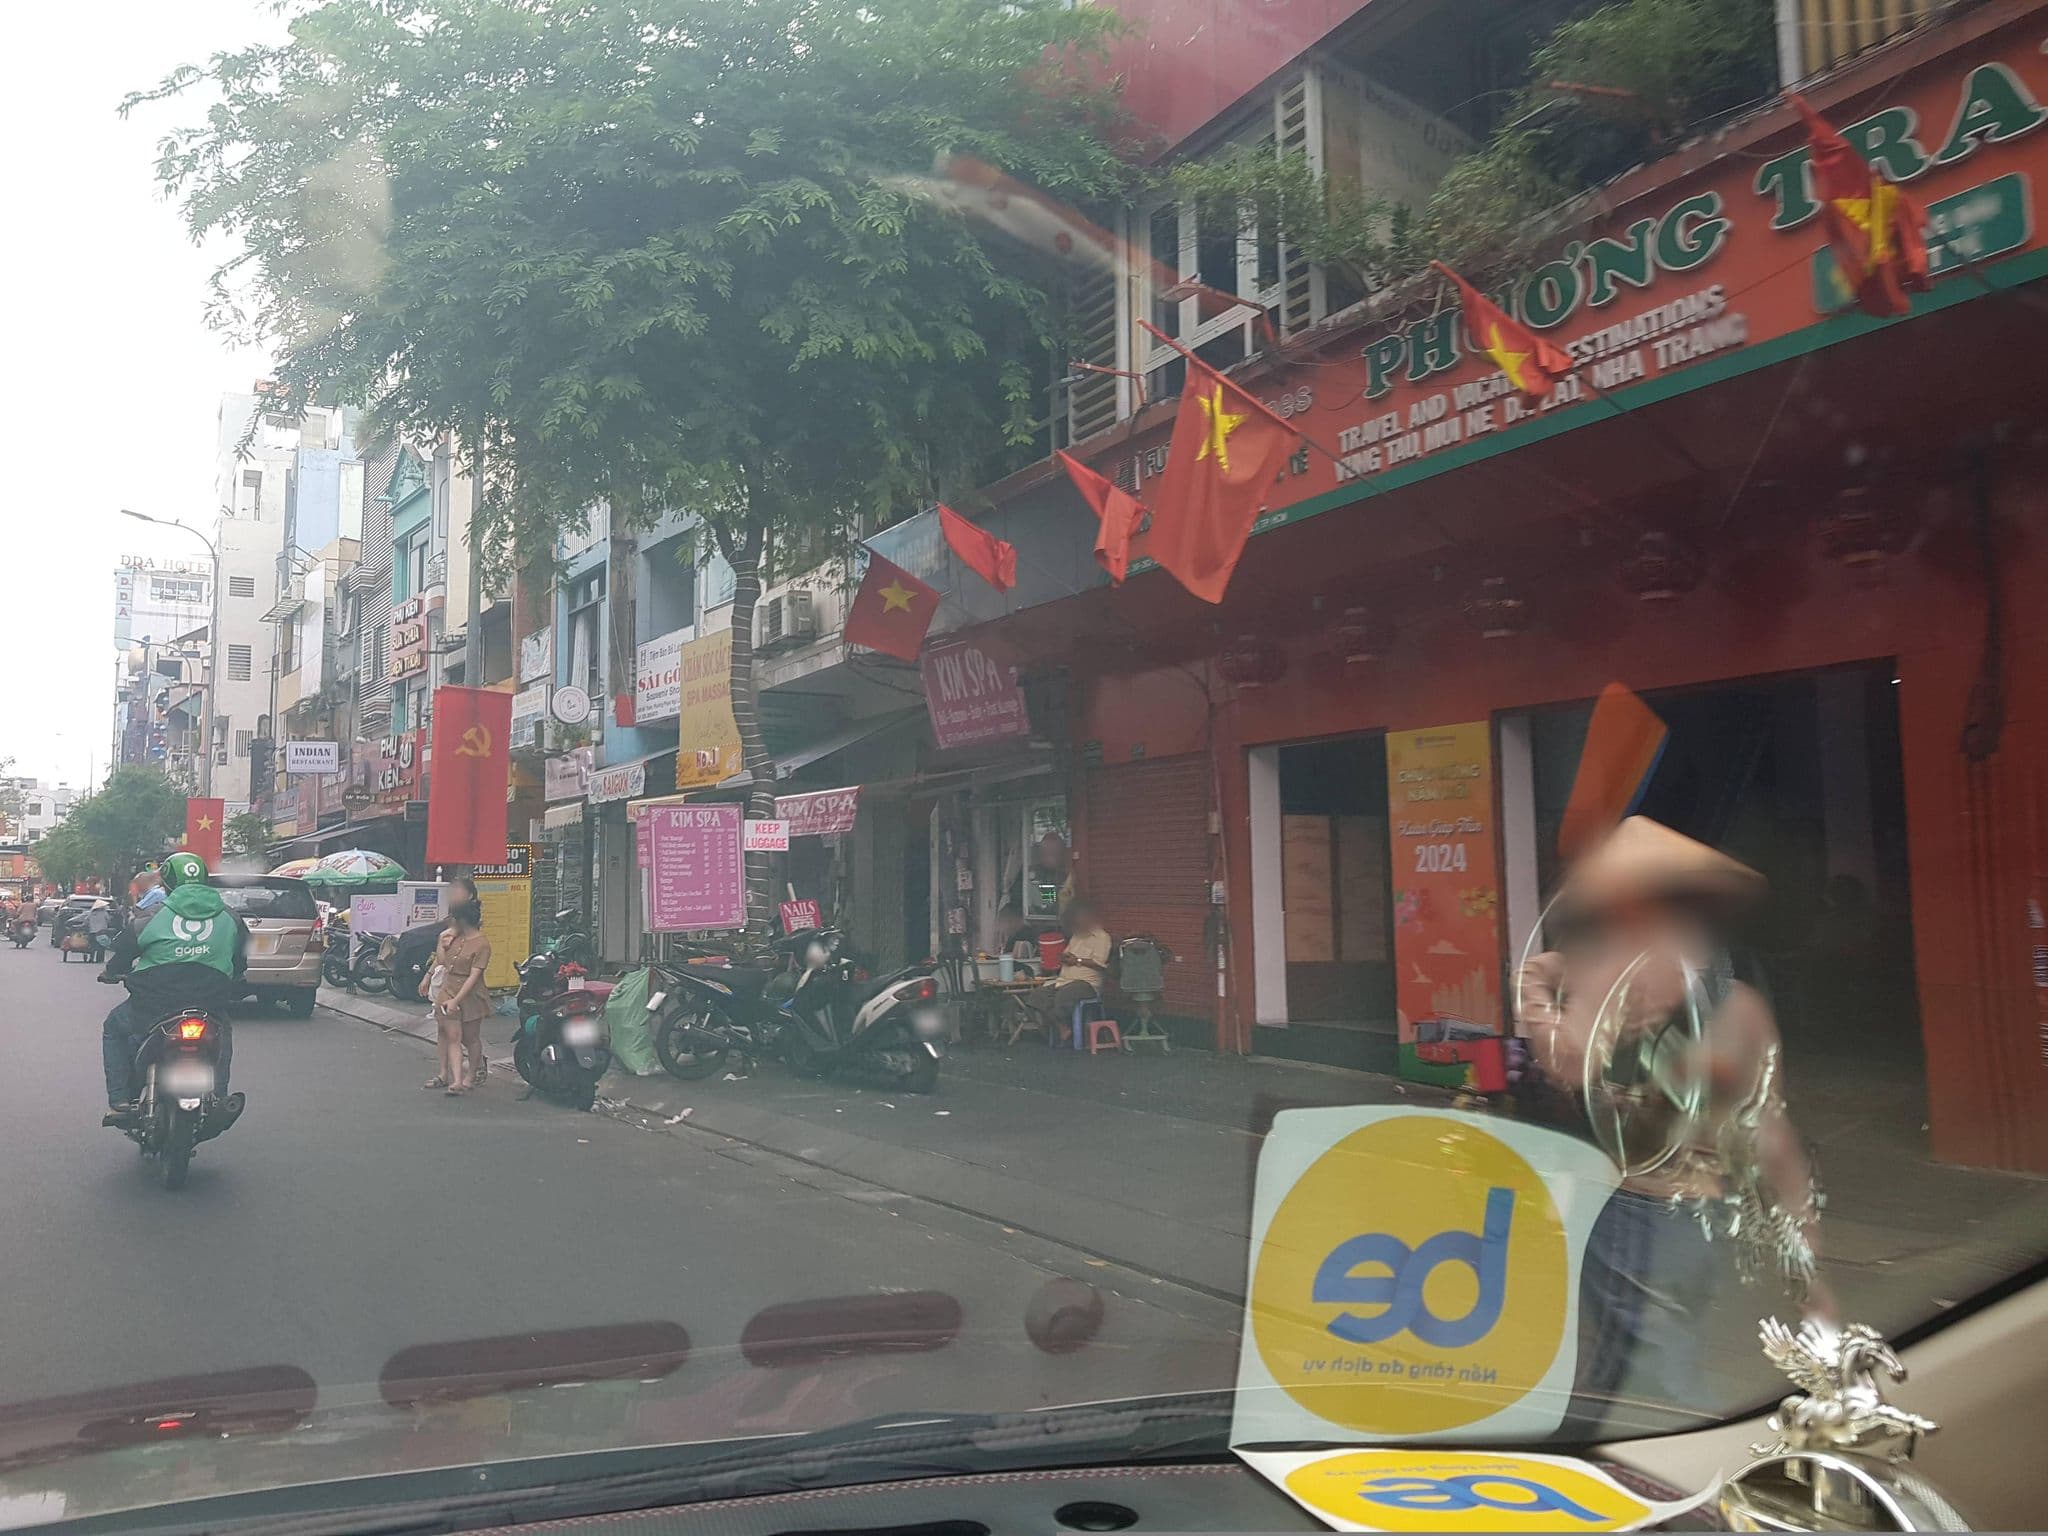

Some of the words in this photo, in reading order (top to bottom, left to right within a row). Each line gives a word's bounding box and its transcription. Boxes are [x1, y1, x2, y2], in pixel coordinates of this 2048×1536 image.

[1753, 60, 2048, 230] TRA
[1338, 410, 1405, 453] TRAVEL
[1409, 392, 1448, 428] AND
[1565, 284, 1727, 367] ESTINATIONS
[1504, 395, 1536, 424] D
[1592, 349, 1647, 390] NHA
[1652, 311, 1748, 370] TRANG
[120, 554, 155, 569] DDA
[663, 661, 680, 686] GÒ
[934, 653, 968, 703] KIM
[669, 685, 680, 697] Sho
[294, 747, 331, 757] INDIAN
[603, 770, 628, 796] SAIGON
[670, 811, 694, 829] KIM
[696, 811, 721, 828] SPA
[754, 823, 781, 835] KEEP
[745, 838, 788, 849] LUGGAGE
[1414, 842, 1468, 874] 2024
[783, 900, 816, 917] NAILS
[174, 944, 210, 957] gojek
